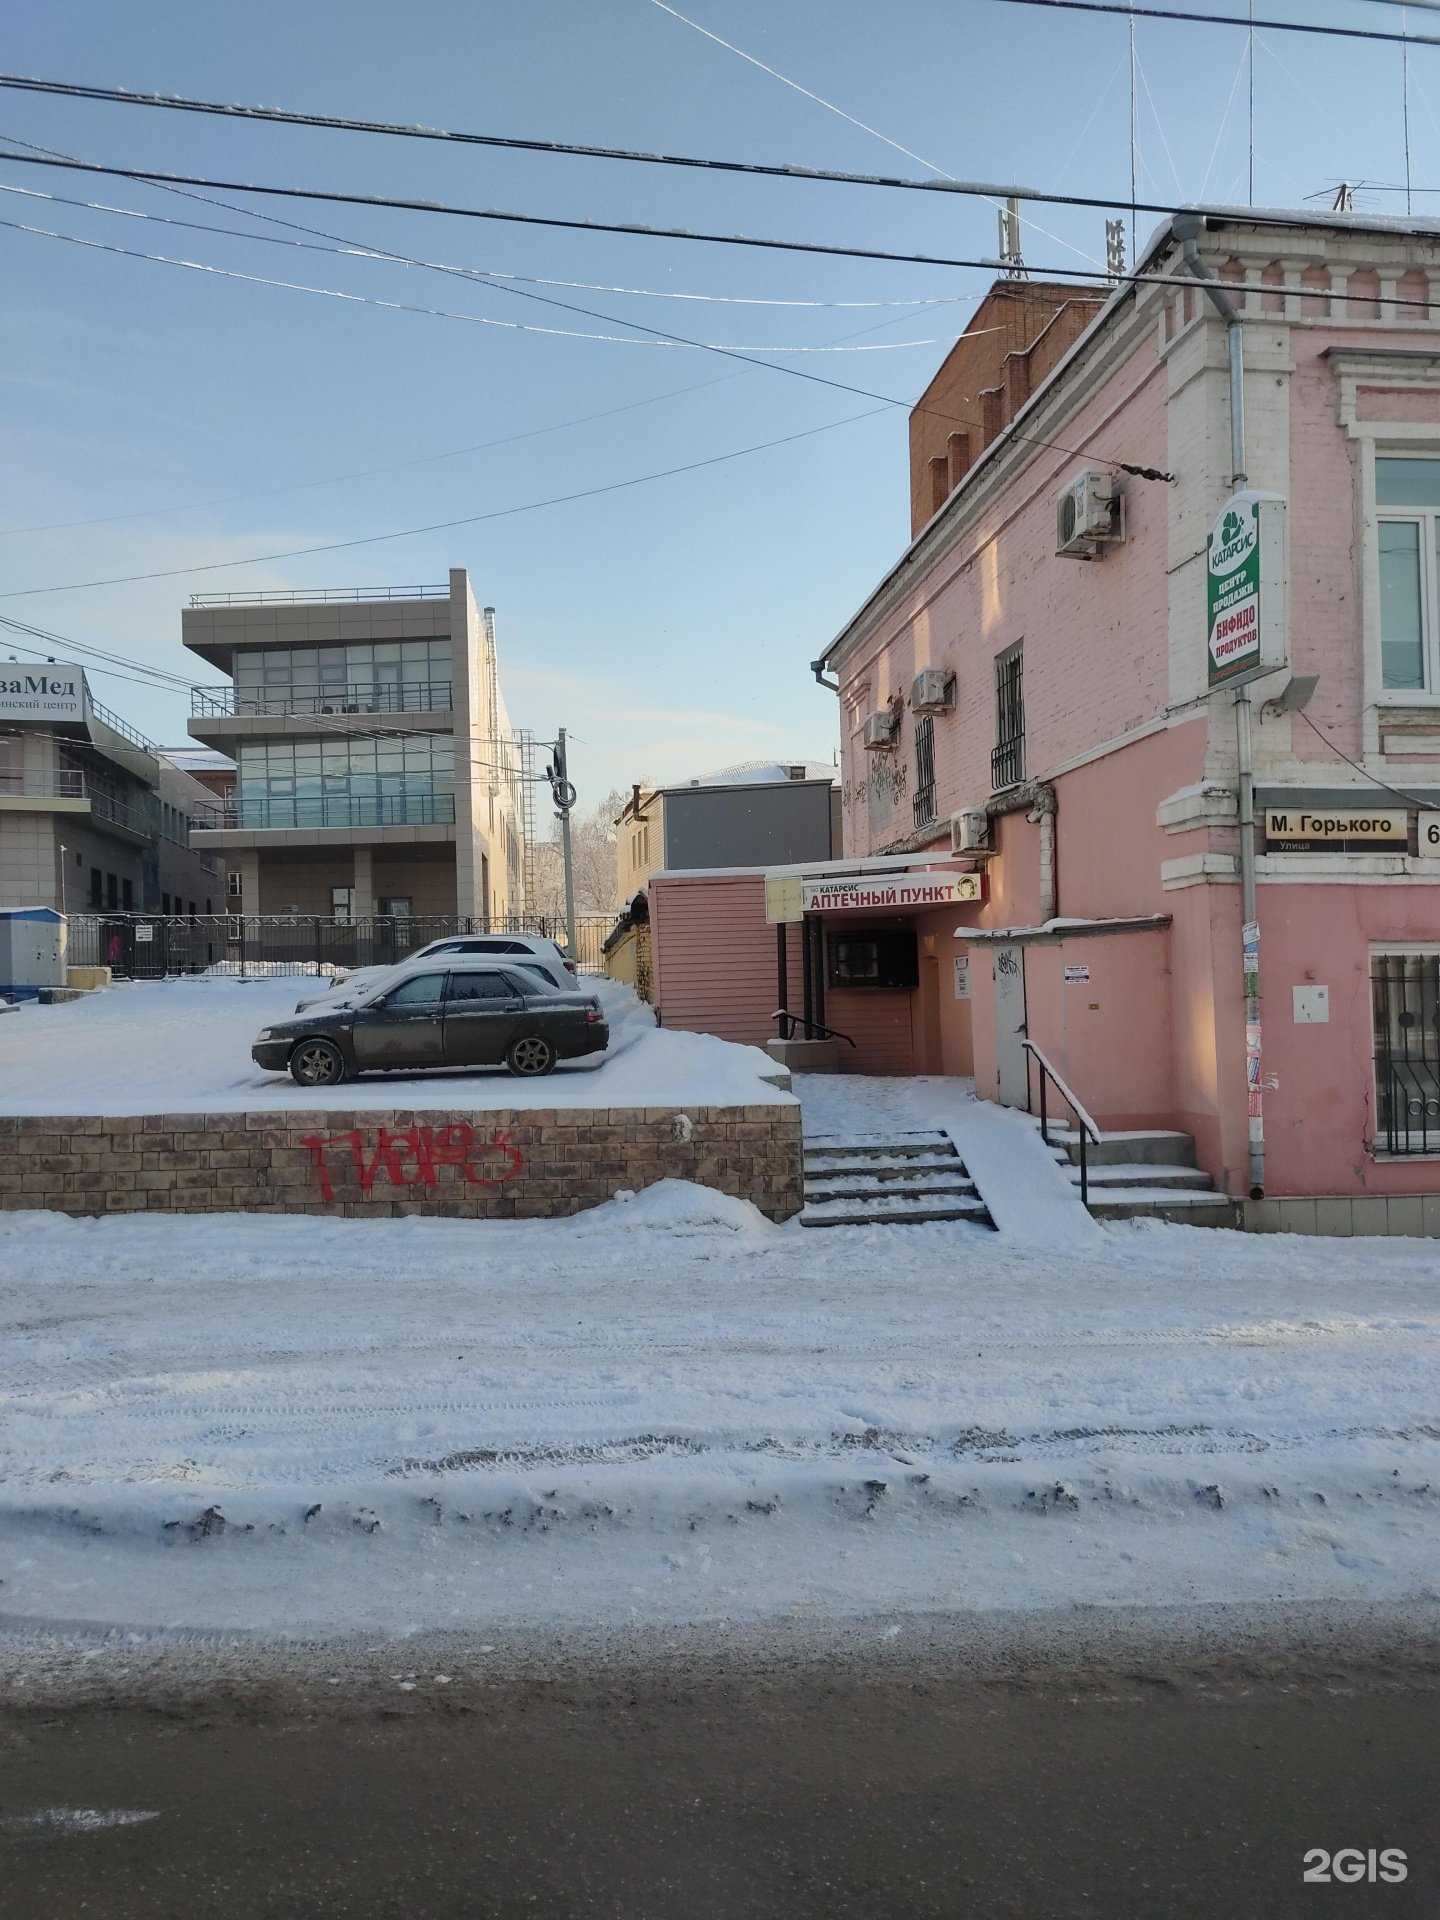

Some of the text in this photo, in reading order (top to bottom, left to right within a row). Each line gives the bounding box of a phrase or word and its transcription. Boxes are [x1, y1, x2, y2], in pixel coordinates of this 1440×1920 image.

[1212, 532, 1253, 569] КАТАРСИС
[1218, 569, 1247, 595] ЦЕНТР
[1212, 581, 1254, 613] ПРОДАЖИ
[1216, 604, 1255, 640] БИФИДО
[1215, 628, 1257, 658] ПРОДУКТОВ
[43, 701, 77, 712] центр
[1271, 815, 1392, 836] М. Горького
[1279, 840, 1311, 851] Улица
[810, 886, 954, 909] АПТЕЧНЫЙ ПУНКТ
[819, 884, 859, 893] КАТАРСИС
